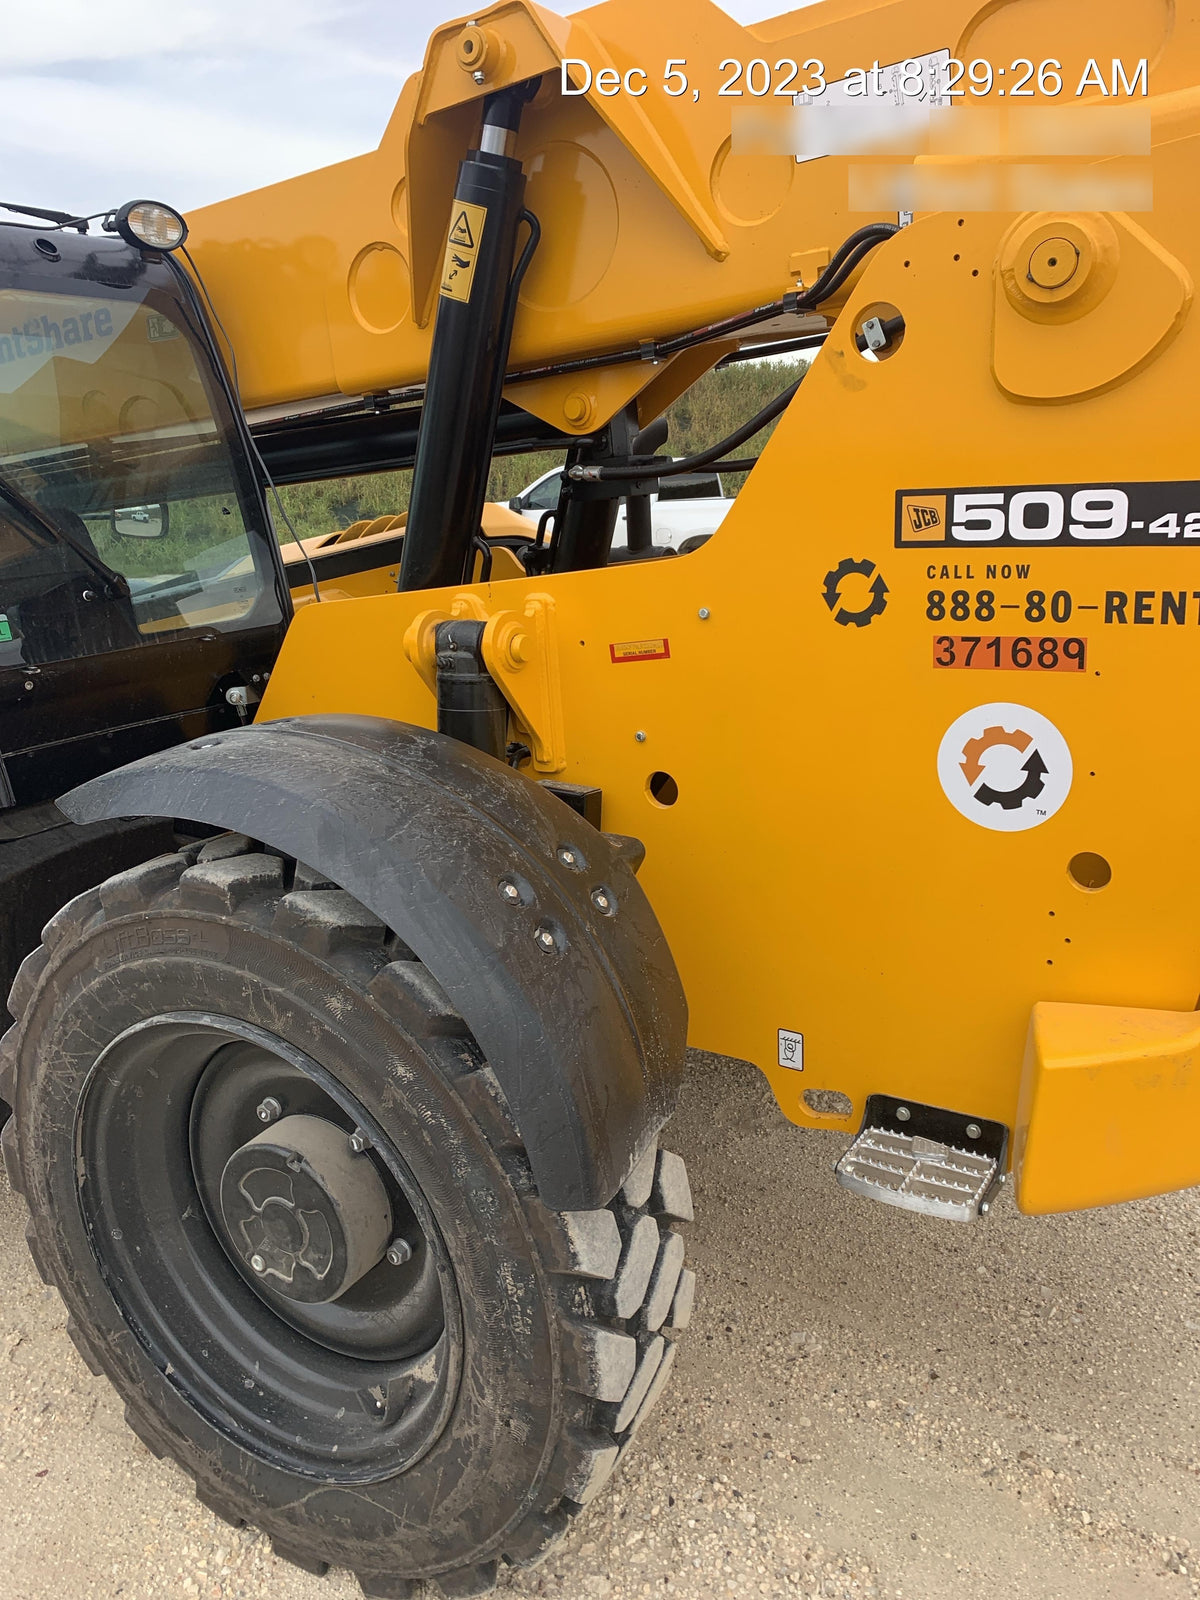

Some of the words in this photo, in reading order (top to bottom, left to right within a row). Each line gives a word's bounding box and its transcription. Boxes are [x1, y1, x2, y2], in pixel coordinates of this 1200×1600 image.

[912, 507, 938, 529] JCB
[926, 564, 975, 580] CALL
[986, 564, 1031, 579] NOW
[935, 635, 1086, 670] 371689
